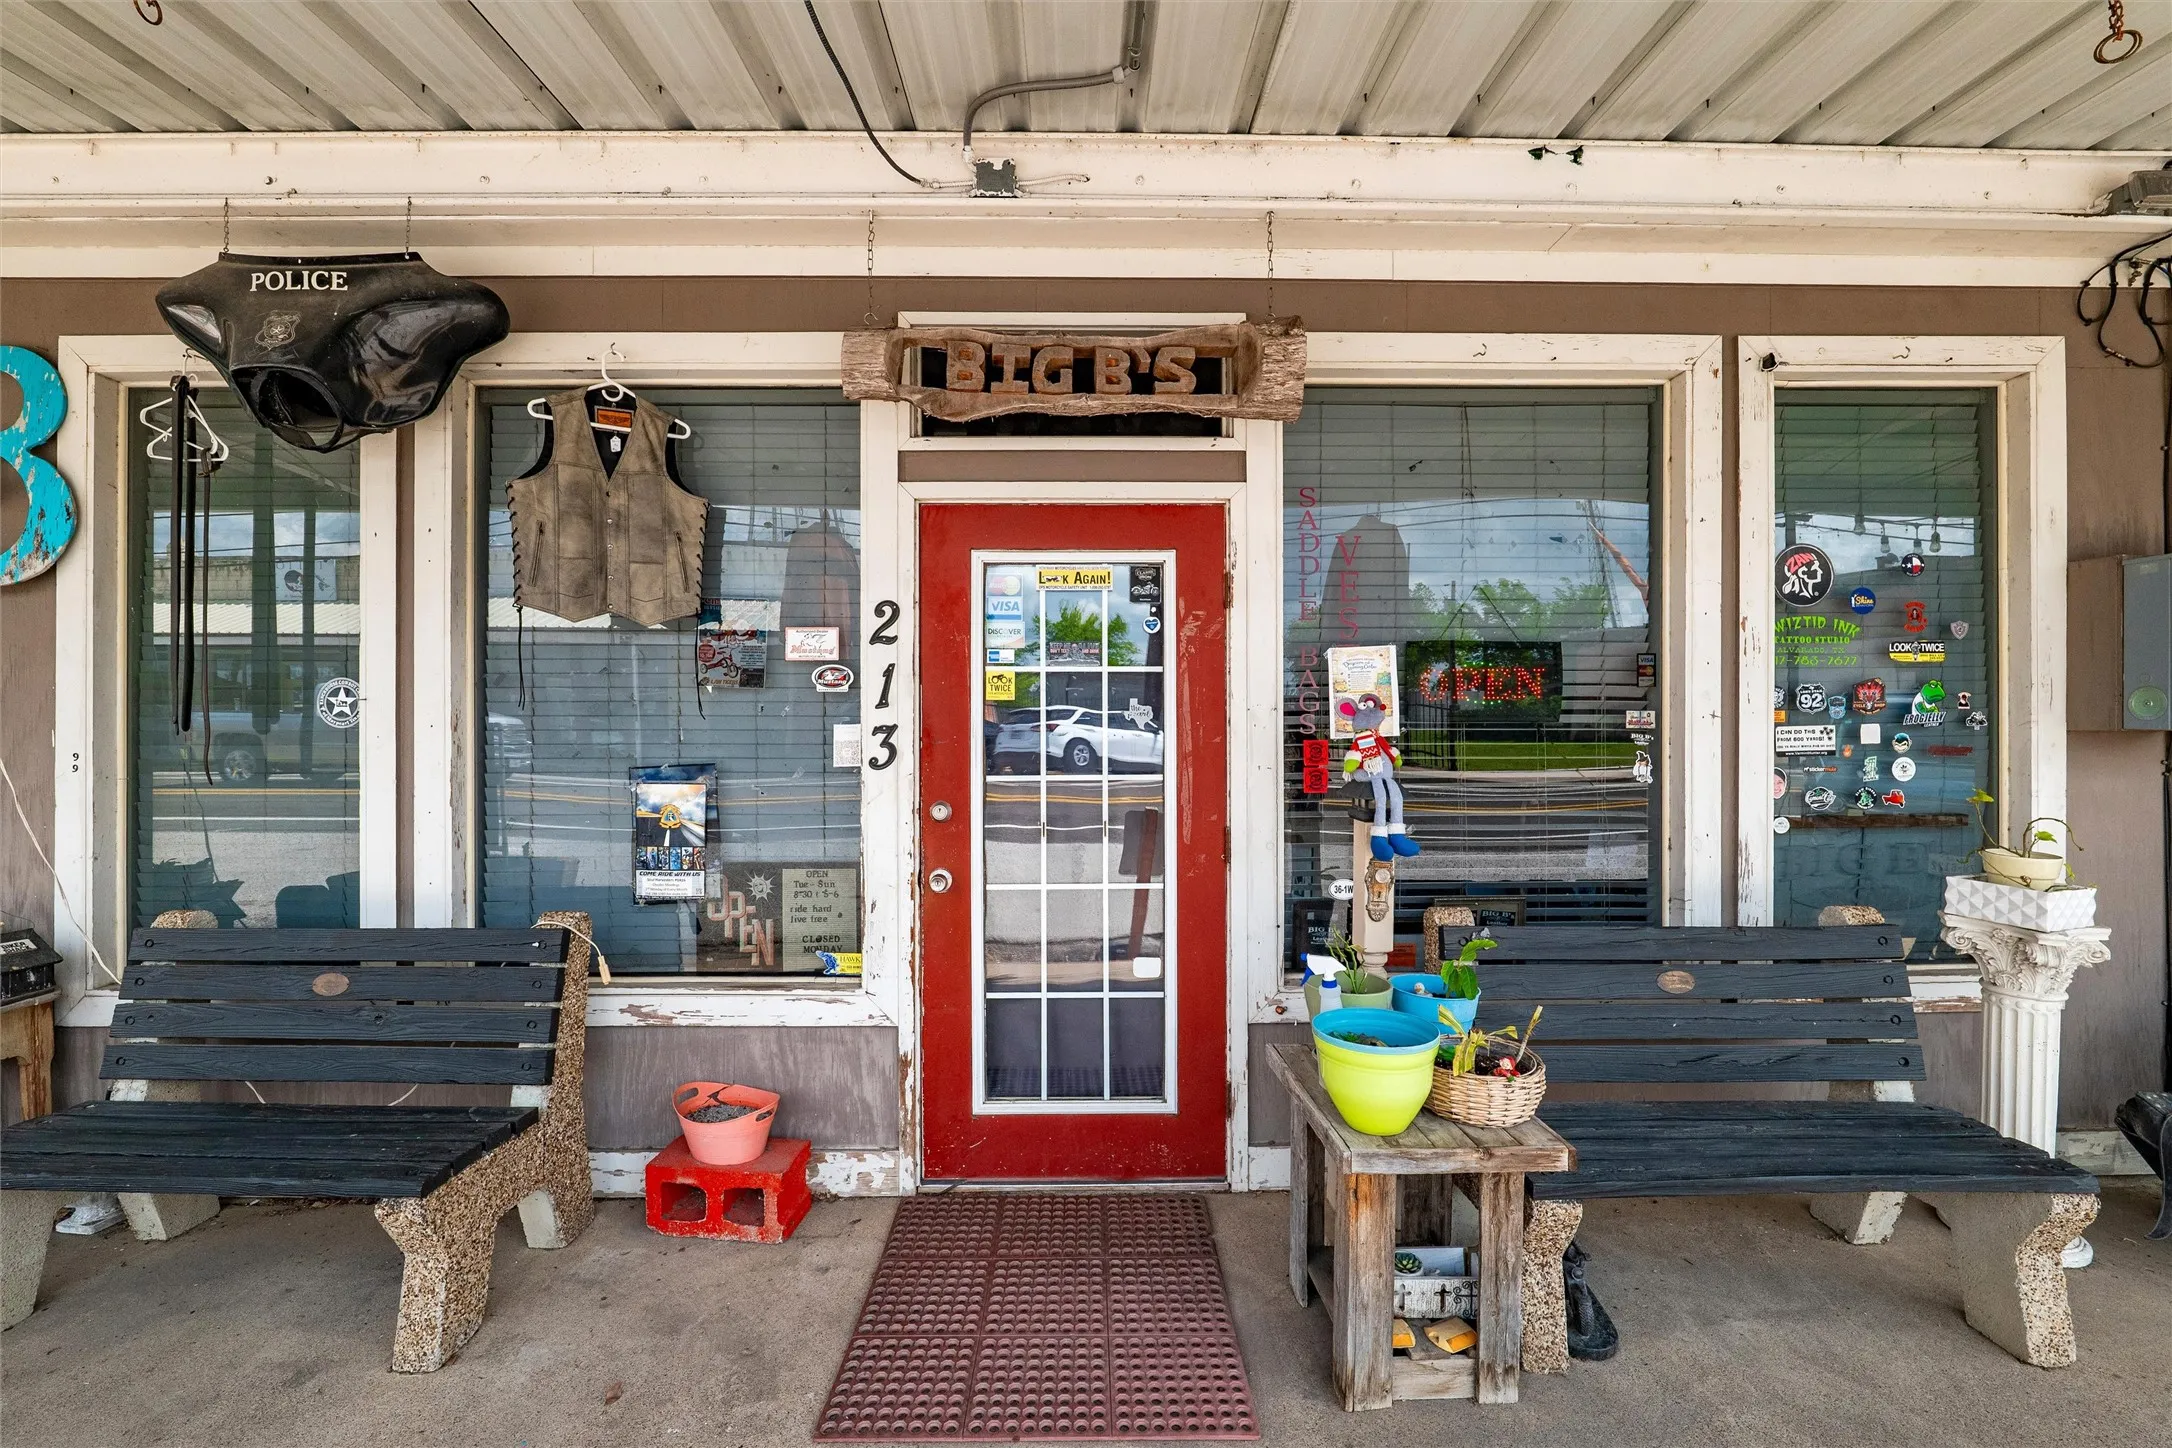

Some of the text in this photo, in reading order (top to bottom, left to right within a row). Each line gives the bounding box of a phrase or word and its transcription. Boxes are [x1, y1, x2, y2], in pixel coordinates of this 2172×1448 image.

[250, 270, 348, 292] POLICE
[947, 340, 1197, 395] BIG B'S
[1297, 487, 1320, 621] SADDLE
[1039, 571, 1111, 584] LK AGAIN!
[1335, 536, 1361, 648] VES
[991, 601, 1020, 611] VISA
[988, 628, 1022, 636] DISCOVER
[1833, 618, 1861, 638] INK
[1775, 636, 1850, 644] TATTOO STUDIO
[790, 645, 836, 655] Mustang
[1889, 643, 1945, 651] LOOK TWICE
[988, 675, 1013, 684] LOOK
[1419, 667, 1545, 700] OPEN
[990, 684, 1012, 692] TWICE
[1299, 646, 1320, 735] BAGS
[1801, 694, 1823, 708] 92
[1903, 711, 1947, 726] FROGJELLY
[806, 870, 829, 878] OPEN
[794, 880, 808, 888] Tue
[818, 880, 835, 888] Sun
[790, 903, 832, 912] ride hard
[707, 874, 775, 966] OPEN
[790, 915, 828, 923] live free
[802, 935, 840, 943] CLOSED
[1, 941, 26, 949] BIKER
[804, 945, 842, 954] MONDAY
